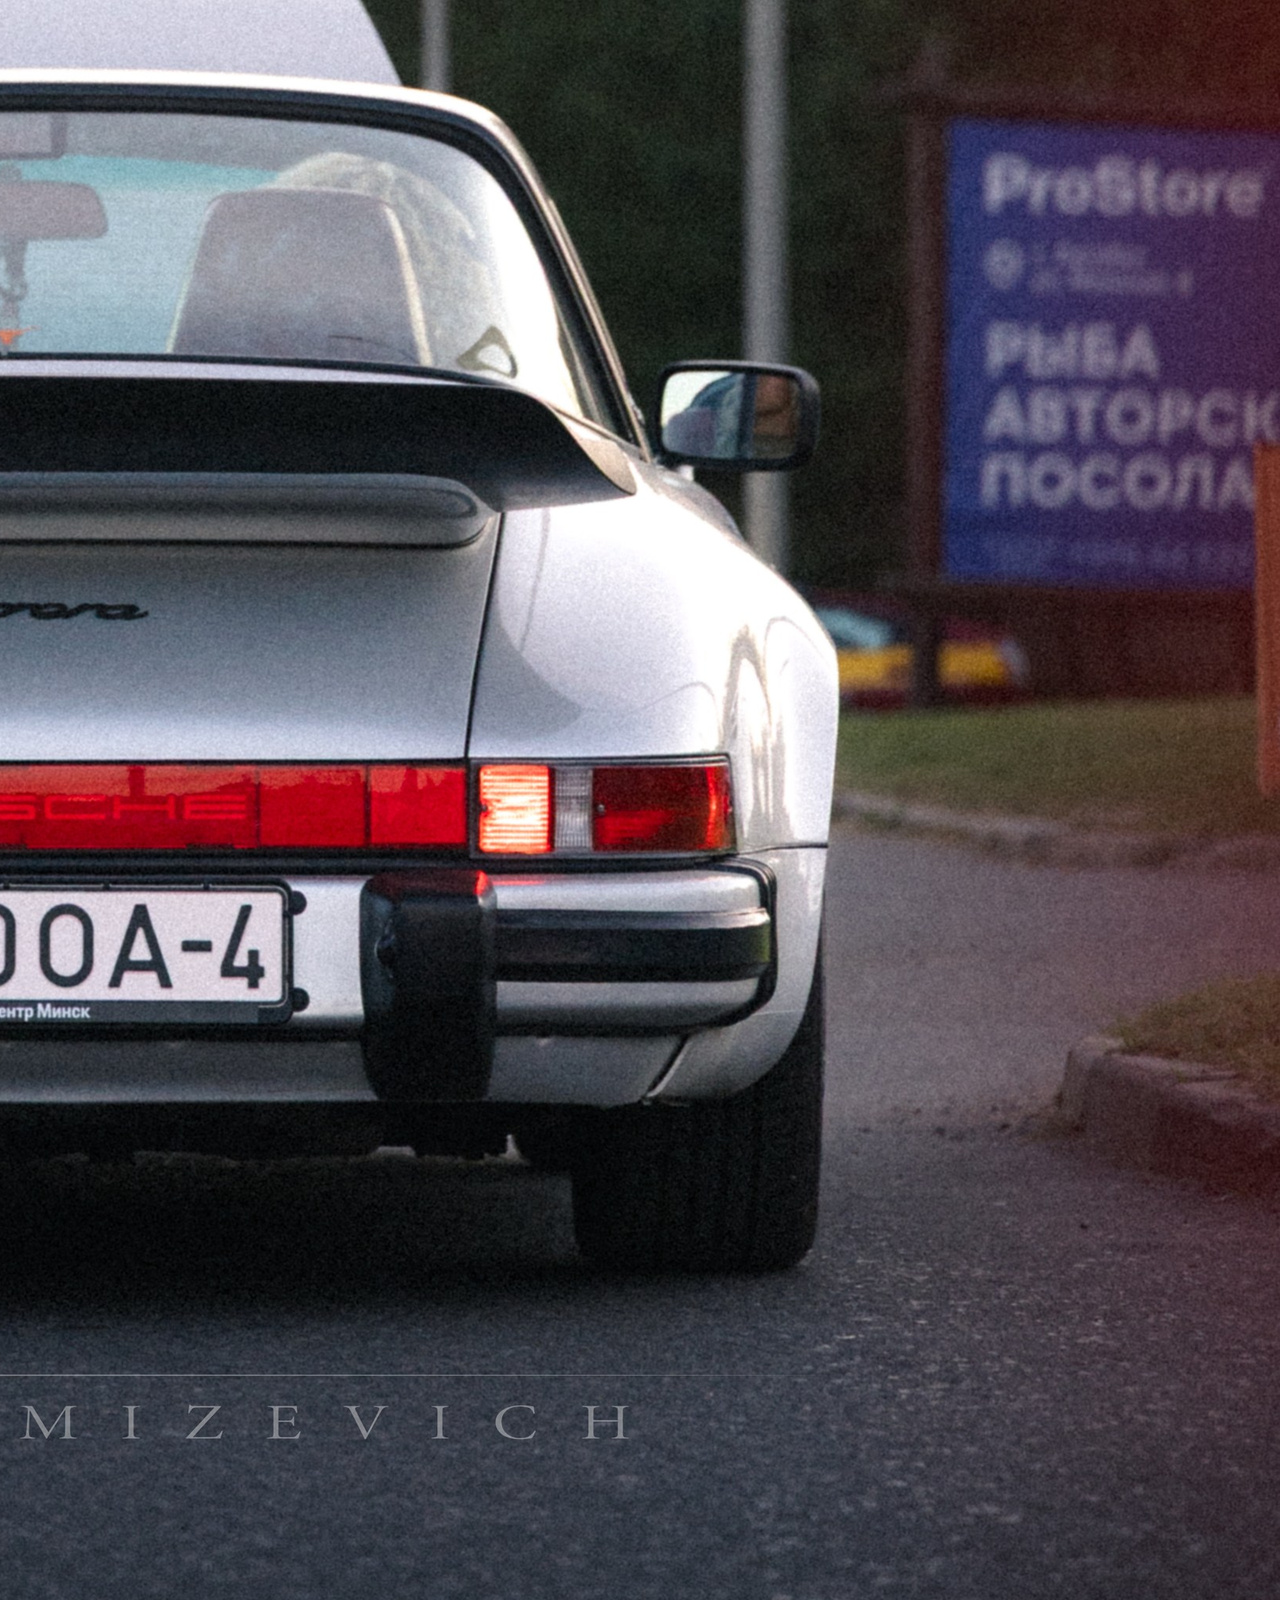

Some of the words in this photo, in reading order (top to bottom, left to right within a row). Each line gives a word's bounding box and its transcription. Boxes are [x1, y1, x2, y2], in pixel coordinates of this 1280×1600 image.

[984, 152, 1263, 216] ProStore
[986, 323, 1160, 378] РЫБА
[36, 1003, 91, 1019] Минск
